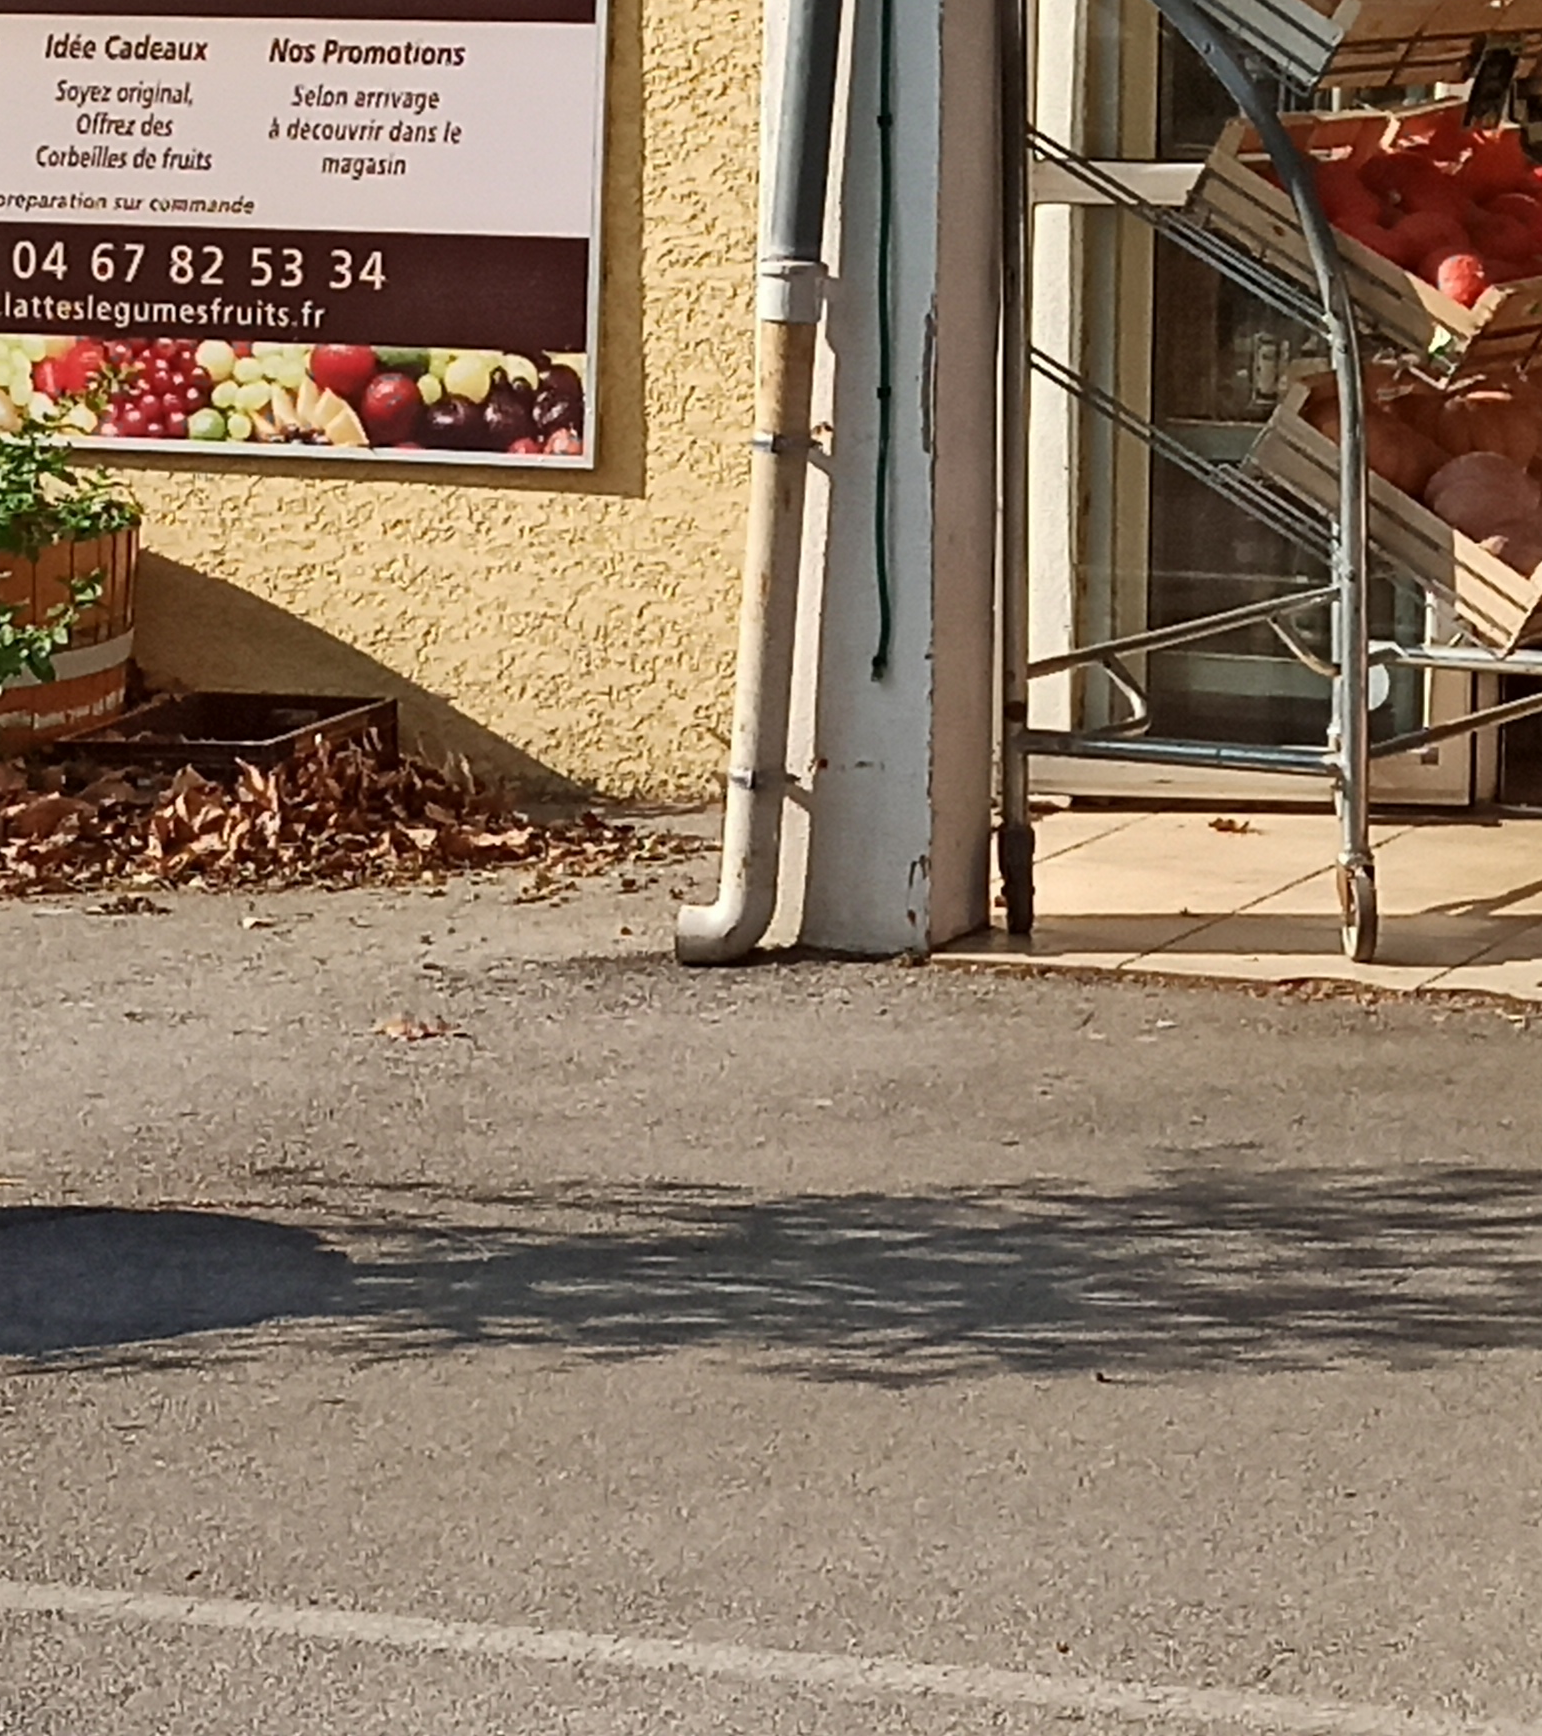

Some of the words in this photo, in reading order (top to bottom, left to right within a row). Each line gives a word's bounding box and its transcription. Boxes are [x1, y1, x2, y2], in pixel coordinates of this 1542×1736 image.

[44, 33, 97, 60] Idée
[104, 34, 209, 62] Cadeaux
[268, 38, 316, 64] Nos
[322, 39, 466, 67] Promotions
[55, 79, 112, 108] Soyez
[116, 81, 194, 109] original,
[291, 84, 348, 108] Selon
[353, 88, 441, 115] arrivage
[76, 113, 136, 137] Offrez
[140, 113, 173, 137] des
[389, 120, 437, 144] dans
[443, 120, 463, 145] le
[36, 145, 128, 169] Corbeilles
[132, 147, 157, 170] de
[162, 147, 213, 172] fruits
[321, 155, 407, 180] magasin
[112, 197, 143, 211] sur
[149, 195, 256, 215] commande
[12, 240, 68, 280] 04
[91, 242, 146, 283] 67
[169, 244, 224, 285] 82
[250, 247, 304, 287] 53
[328, 249, 387, 291] 34
